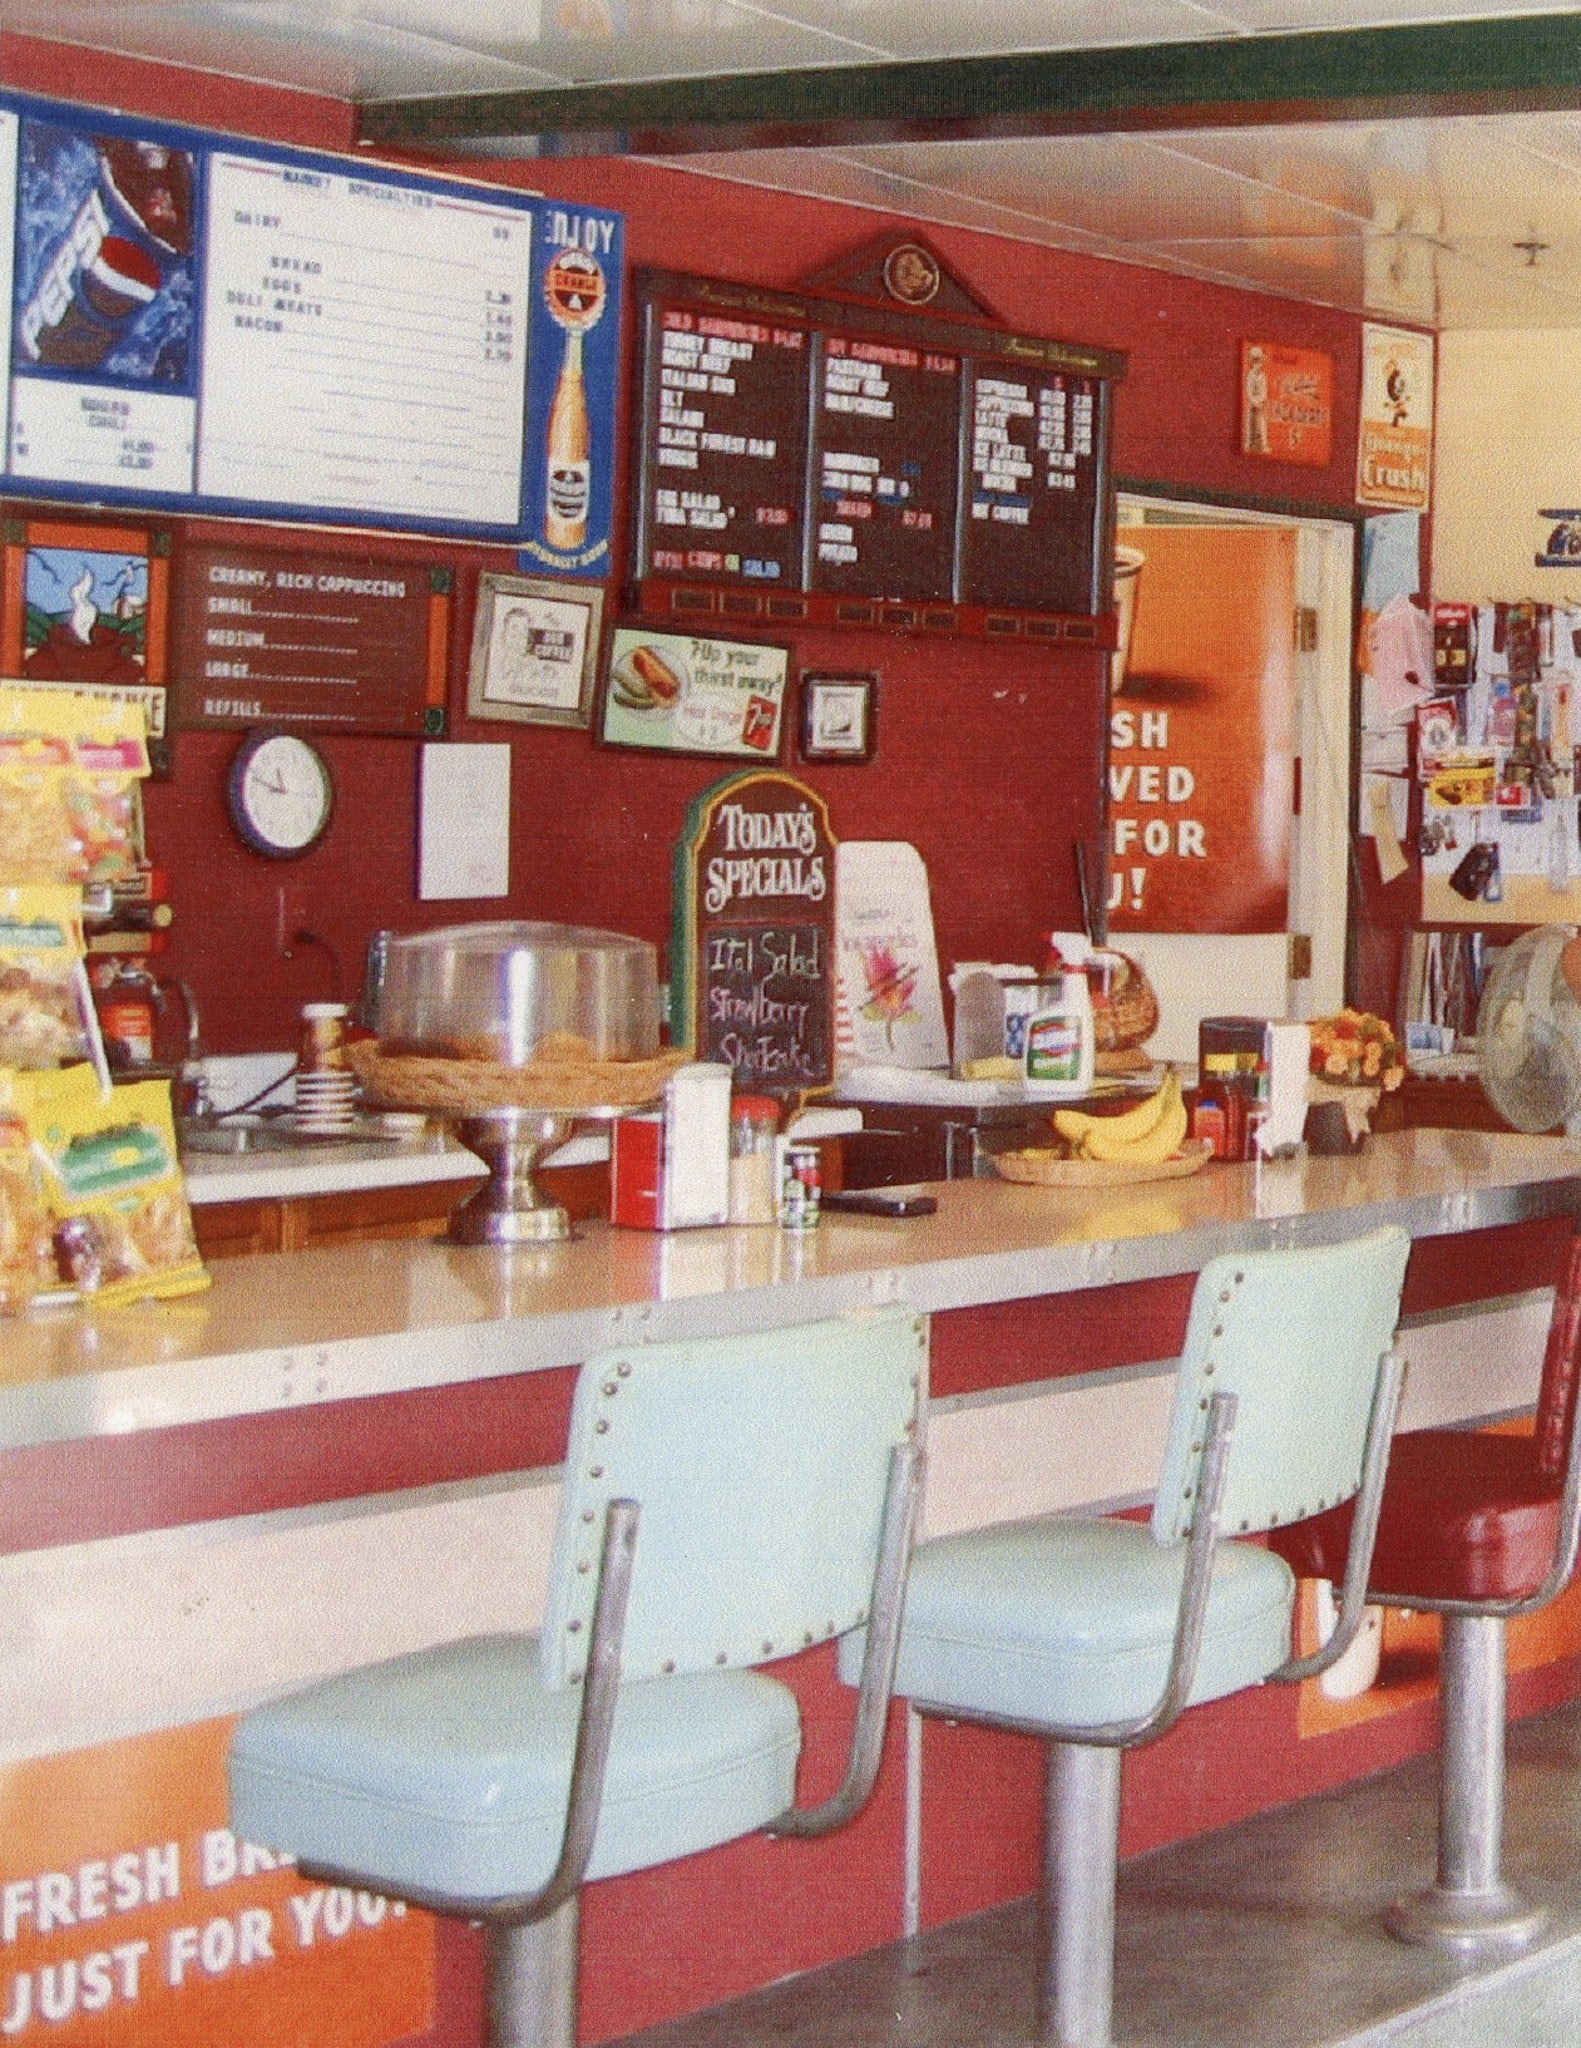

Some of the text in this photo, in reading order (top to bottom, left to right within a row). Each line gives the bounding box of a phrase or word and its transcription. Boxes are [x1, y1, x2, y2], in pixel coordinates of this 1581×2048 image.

[234, 211, 281, 230] DAIRY
[270, 256, 322, 275] BREAD
[262, 277, 302, 295] EGGS
[233, 315, 284, 333] BACON
[208, 566, 406, 598] CREAMY, RICH CAPPUCCINO
[207, 596, 253, 615] SMALL
[206, 629, 265, 648] MEDIUM
[205, 661, 250, 678] LARGE
[203, 699, 263, 718] REFILLS
[717, 801, 817, 856] TODAY'S
[1113, 818, 1208, 858] FOR
[705, 855, 827, 913] SPECIALS
[1, 1842, 181, 1944] FRESH
[1, 1940, 150, 2035] JUST
[168, 1906, 275, 1988] FOR
